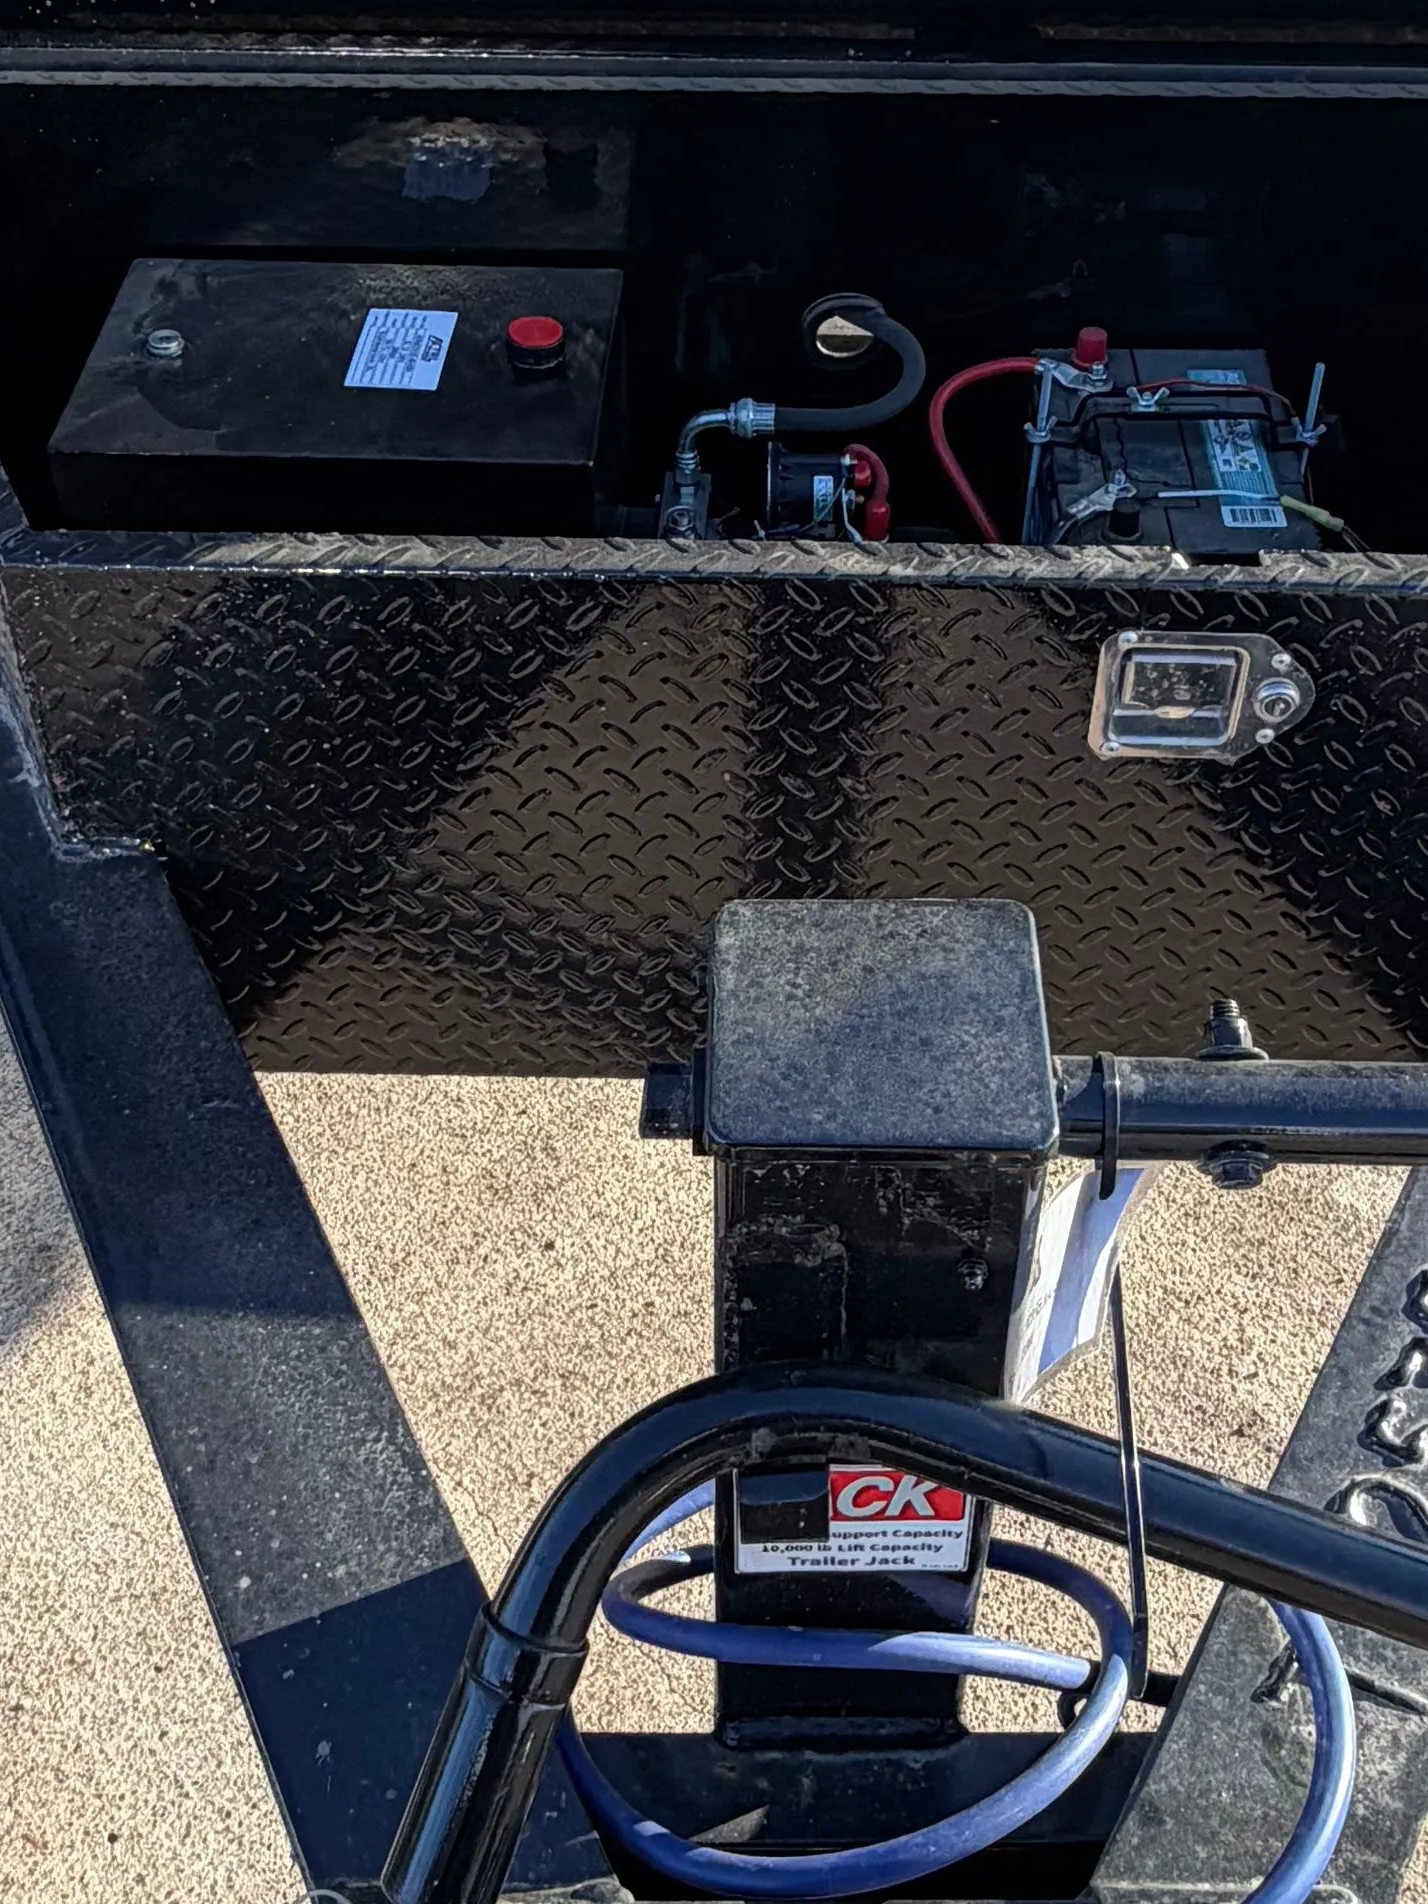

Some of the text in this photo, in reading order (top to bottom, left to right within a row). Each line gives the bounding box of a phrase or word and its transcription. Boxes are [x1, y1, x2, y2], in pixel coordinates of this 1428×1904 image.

[830, 1475, 938, 1517] CK
[828, 1529, 963, 1540] upport Capacity
[817, 1542, 832, 1552] lb
[837, 1543, 866, 1552] Lift
[869, 1543, 944, 1553] Capacity
[787, 1556, 861, 1566] Trailer
[864, 1555, 916, 1566] Jack
